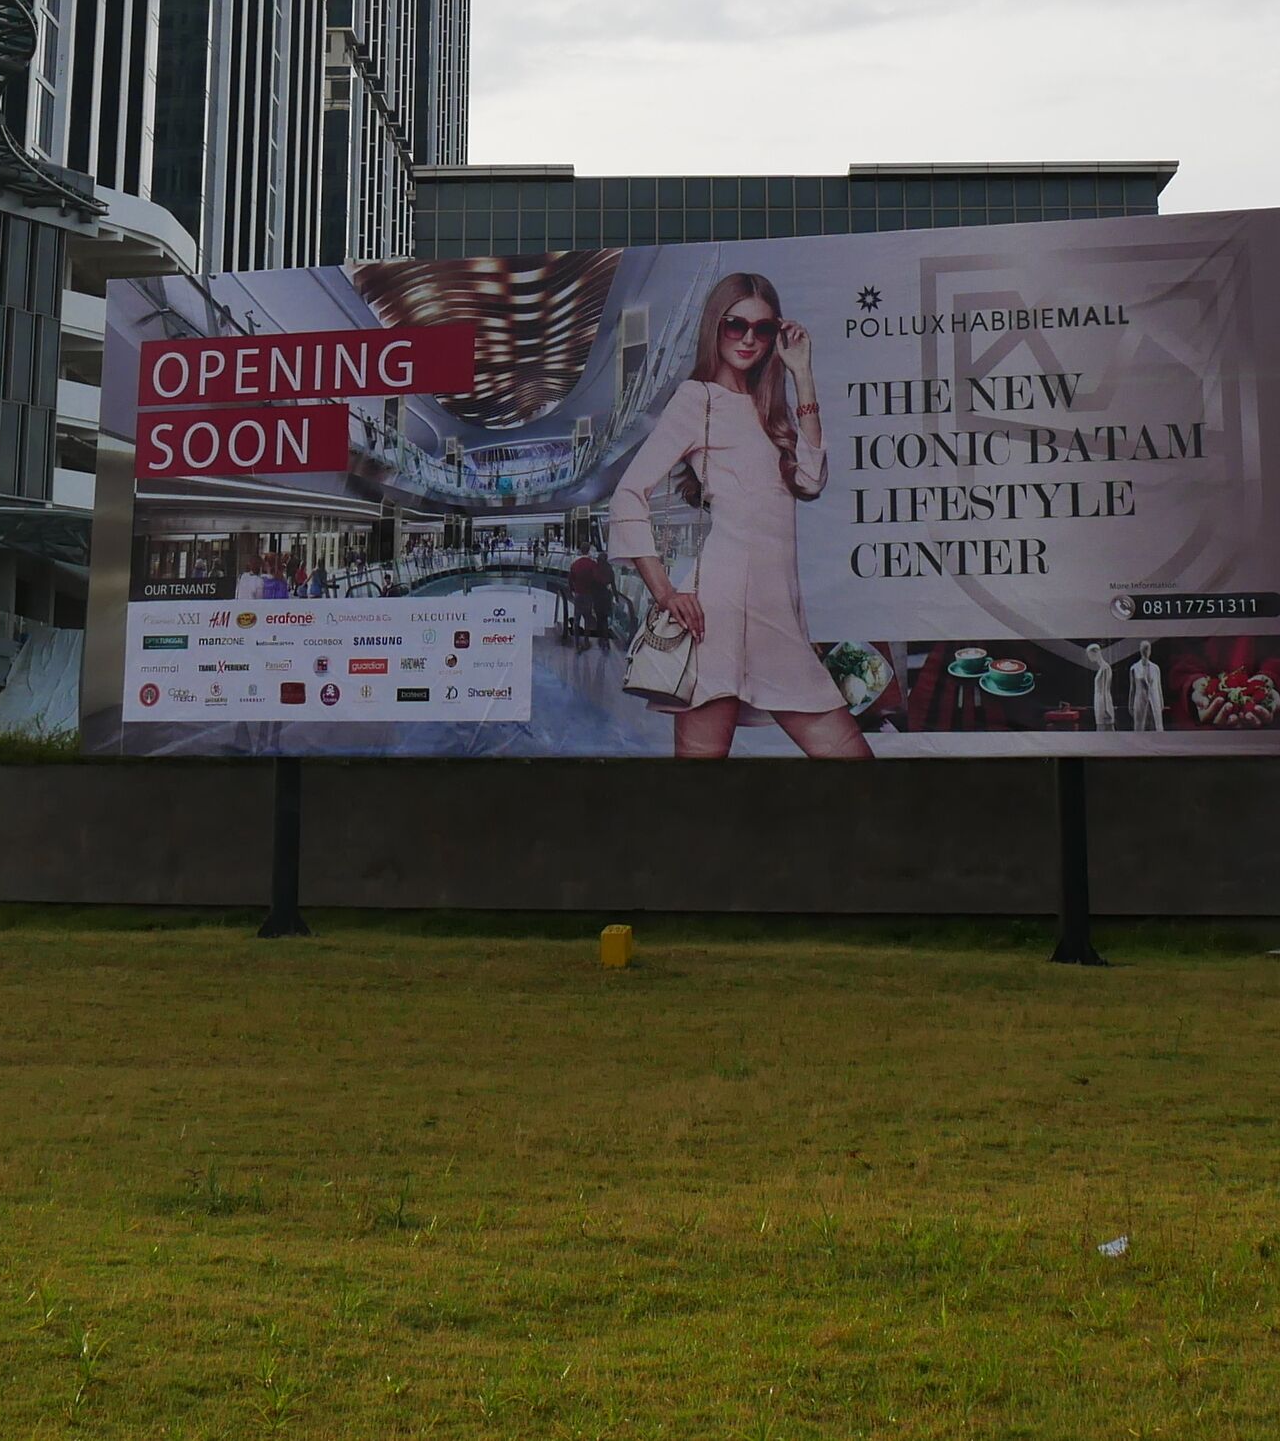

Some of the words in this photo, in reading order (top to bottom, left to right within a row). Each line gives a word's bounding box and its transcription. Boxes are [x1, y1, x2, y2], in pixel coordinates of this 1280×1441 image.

[151, 339, 415, 400] OPENING
[847, 379, 951, 418] THE
[964, 372, 1083, 413] NEW
[147, 418, 310, 472] SOON
[849, 429, 1012, 471] ICONIC
[1026, 422, 1207, 465] BATAM
[851, 480, 1136, 525] LIFESTYLE
[850, 537, 1050, 579] CENTER
[144, 584, 167, 596] OUR
[169, 583, 216, 595] TENANTS
[1109, 582, 1129, 590] More
[1142, 598, 1258, 615] 08117751311
[177, 613, 200, 625] XXI
[266, 613, 313, 624] erafone
[338, 614, 374, 622] DIAMOND
[411, 613, 468, 622] EXECUTIVE
[303, 638, 343, 646] COLORBOX
[353, 636, 402, 646] SAMSUNG
[141, 664, 180, 673] minimal
[351, 663, 386, 672] guardian
